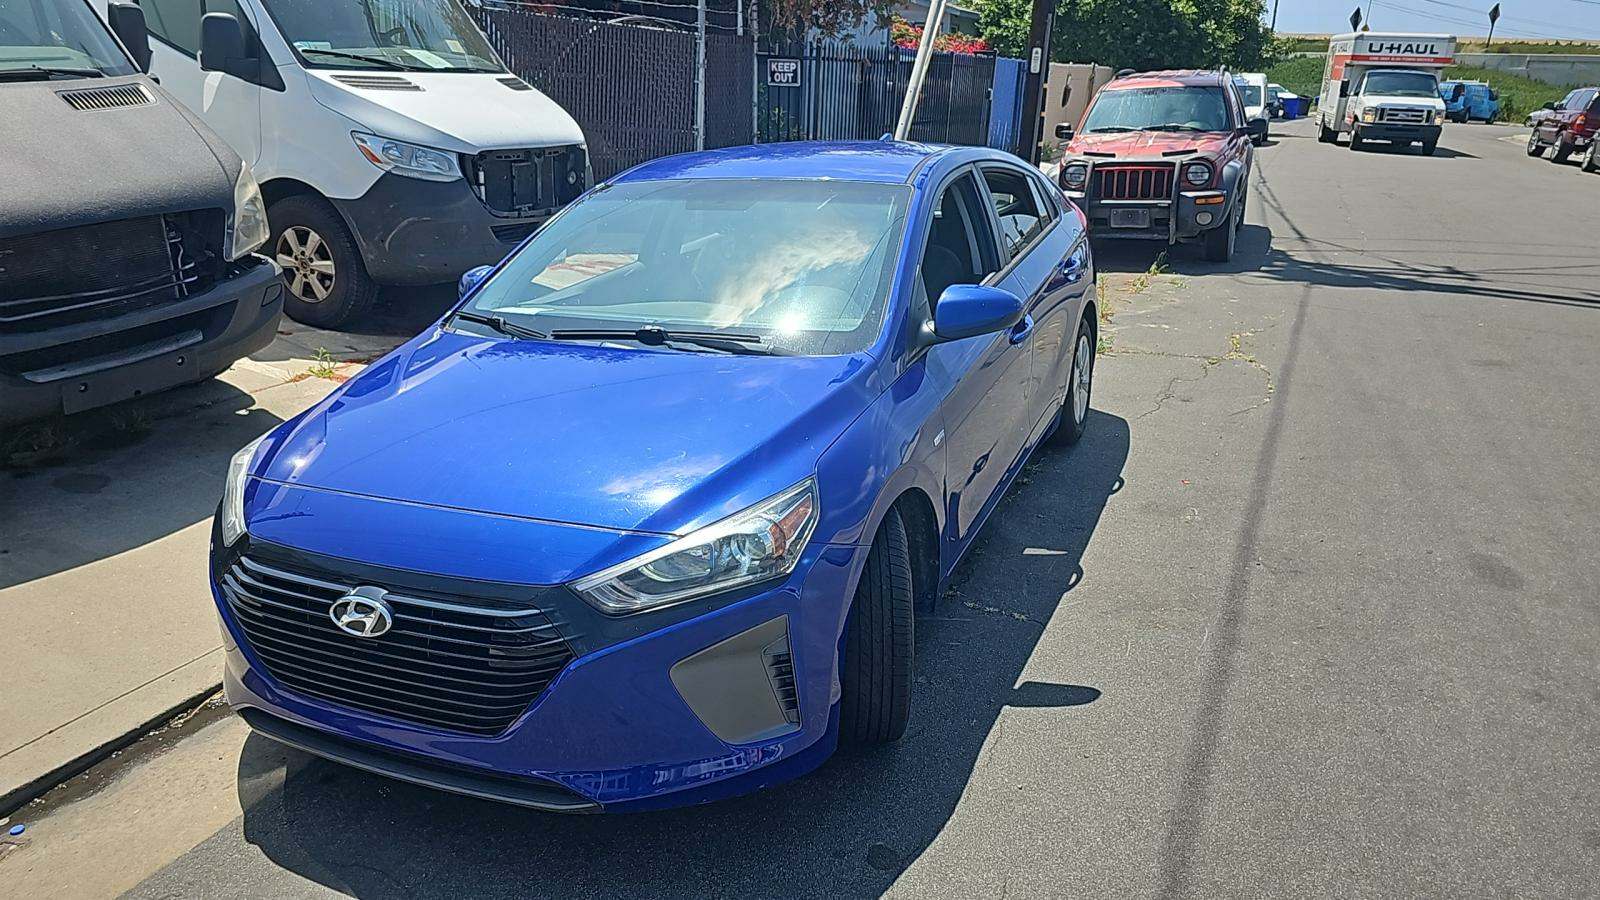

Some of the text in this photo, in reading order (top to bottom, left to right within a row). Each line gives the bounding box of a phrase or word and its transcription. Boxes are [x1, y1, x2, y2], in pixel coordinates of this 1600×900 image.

[1368, 42, 1439, 55] U-HAUL
[771, 62, 797, 72] KEEP
[774, 72, 794, 82] OUT
